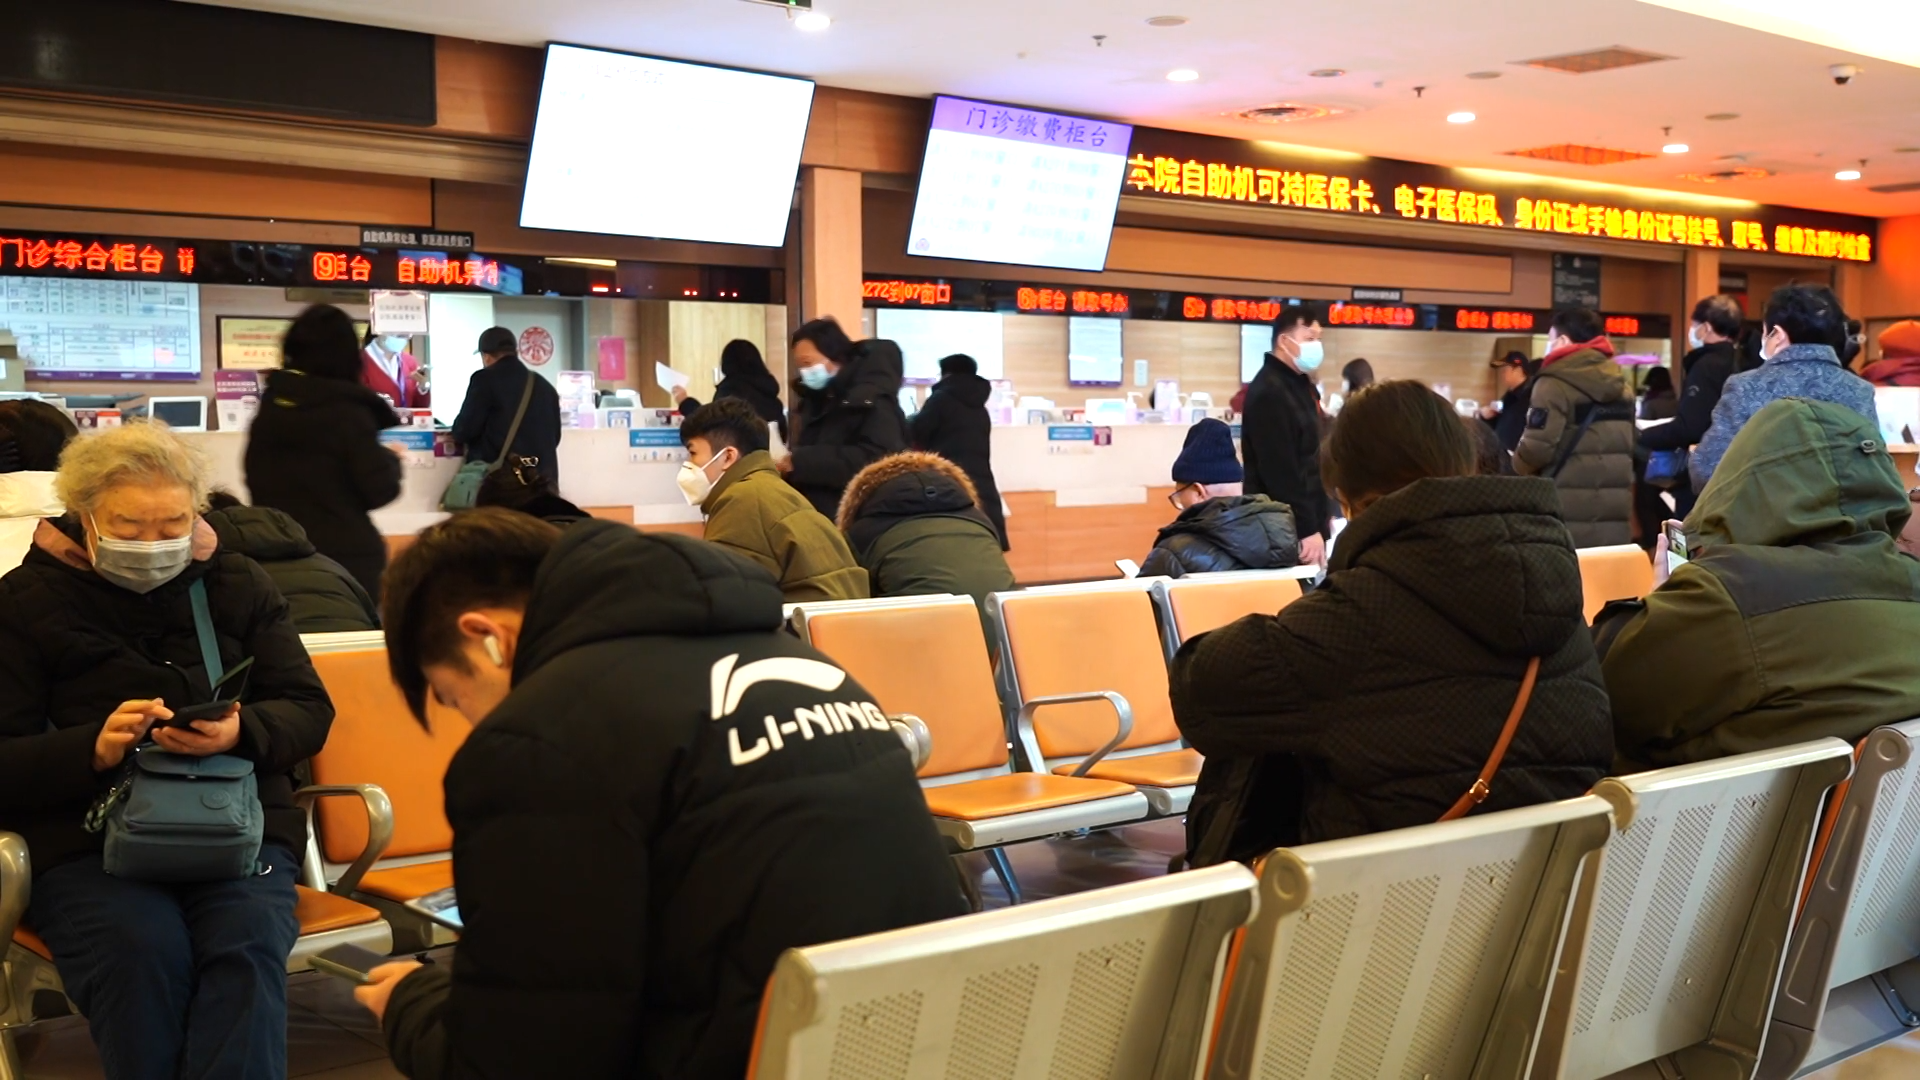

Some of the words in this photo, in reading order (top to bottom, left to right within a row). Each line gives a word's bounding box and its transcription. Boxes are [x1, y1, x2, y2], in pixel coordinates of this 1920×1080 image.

[966, 106, 1109, 148] 门诊缴费柜台
[0, 237, 164, 274] 门诊综合柜台
[727, 700, 891, 767] LI-NING
